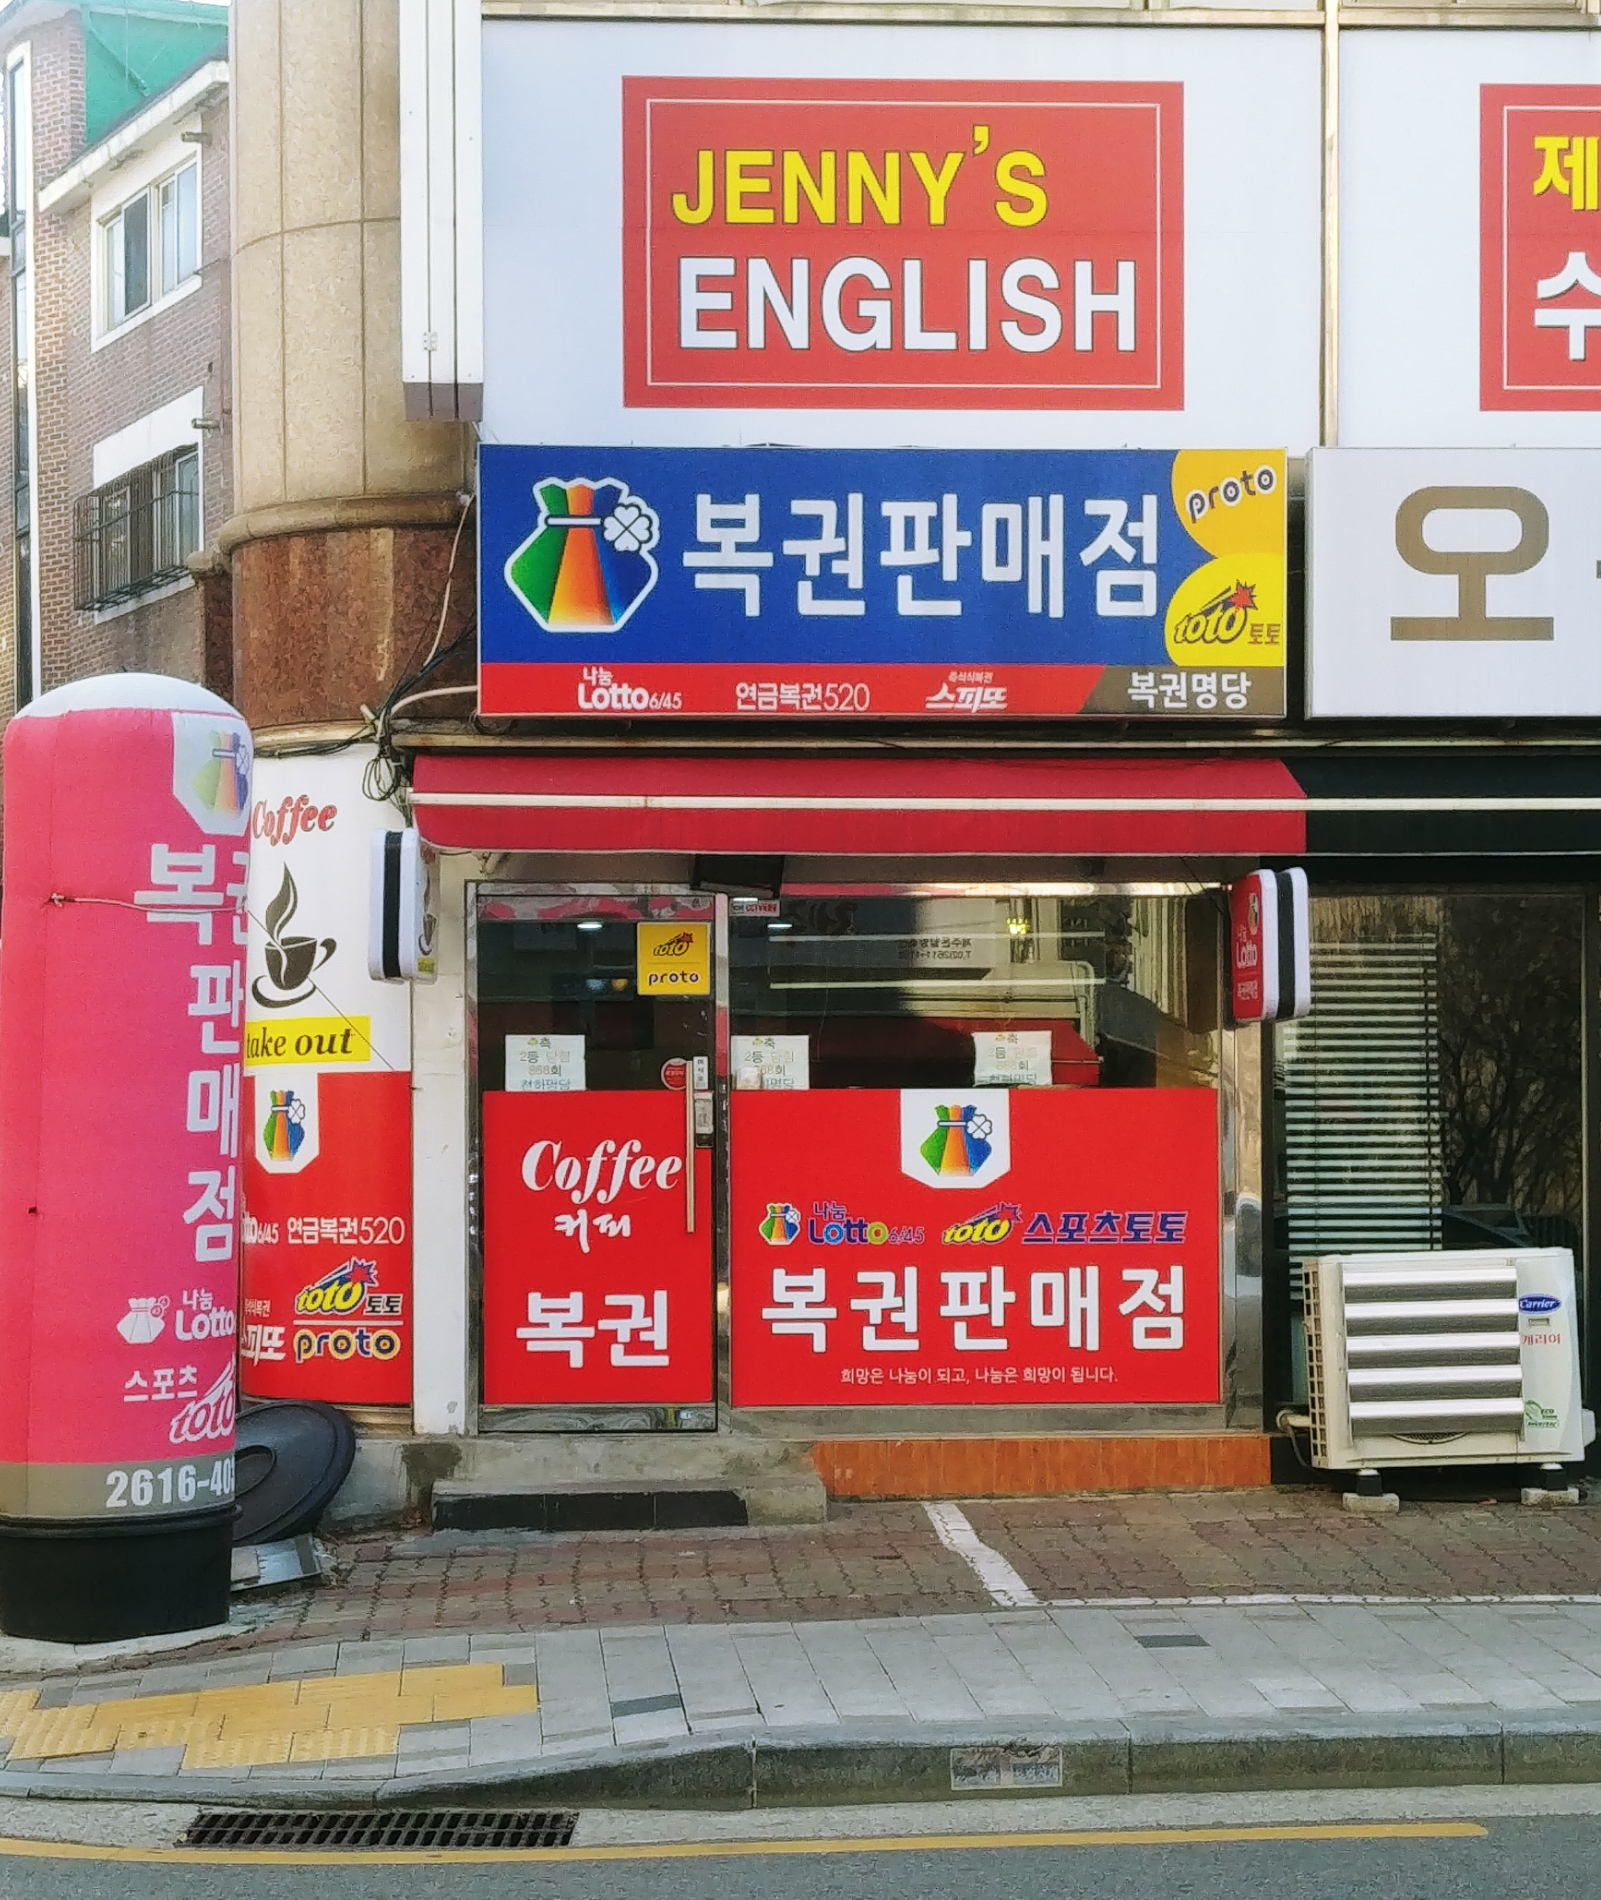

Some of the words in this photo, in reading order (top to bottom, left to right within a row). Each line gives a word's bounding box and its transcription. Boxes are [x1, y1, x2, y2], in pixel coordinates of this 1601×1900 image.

[671, 125, 1048, 227] JENNY'S
[679, 256, 1136, 352] ENGLISH
[1186, 465, 1277, 524] proto
[683, 493, 1158, 618] 복권판매점
[1390, 486, 1601, 641] 오
[1174, 598, 1249, 645] toto
[1248, 623, 1281, 645] 토토
[583, 666, 613, 686] 나눔
[1127, 672, 1252, 709] 복권명당
[735, 682, 870, 711] 연금복권520
[925, 682, 1008, 713] 스피또
[253, 795, 338, 846] Coffee
[653, 938, 690, 957] toto
[648, 970, 700, 986] proto
[246, 1026, 287, 1059] take
[295, 1028, 355, 1057] out
[520, 1050, 539, 1064] 2등
[183, 959, 244, 1262] 판매점
[522, 1139, 683, 1205] Coffee
[814, 1201, 846, 1220] 나눔
[1022, 1210, 1188, 1245] 스포츠토토
[287, 1216, 406, 1245] 연금복권520
[554, 1208, 632, 1254] 커피
[943, 1213, 1013, 1245] toto
[183, 1289, 213, 1310] 나눔
[295, 1280, 367, 1314] toto
[366, 1296, 402, 1314] 토토
[761, 1265, 1186, 1354] 복권판매점
[1520, 1298, 1556, 1311] Carrier
[175, 1305, 236, 1341] Lotto
[516, 1290, 669, 1368] 복권
[293, 1328, 401, 1363] proto
[123, 1365, 198, 1402] 스포츠
[840, 1367, 885, 1385] 희망은
[888, 1367, 932, 1385] 나눔이
[936, 1367, 970, 1385] 되고,
[975, 1367, 1018, 1385] 나눔은
[1022, 1367, 1066, 1385] 희망이
[1070, 1367, 1118, 1385] 됩니다.
[105, 1456, 235, 1508] 2616-40
